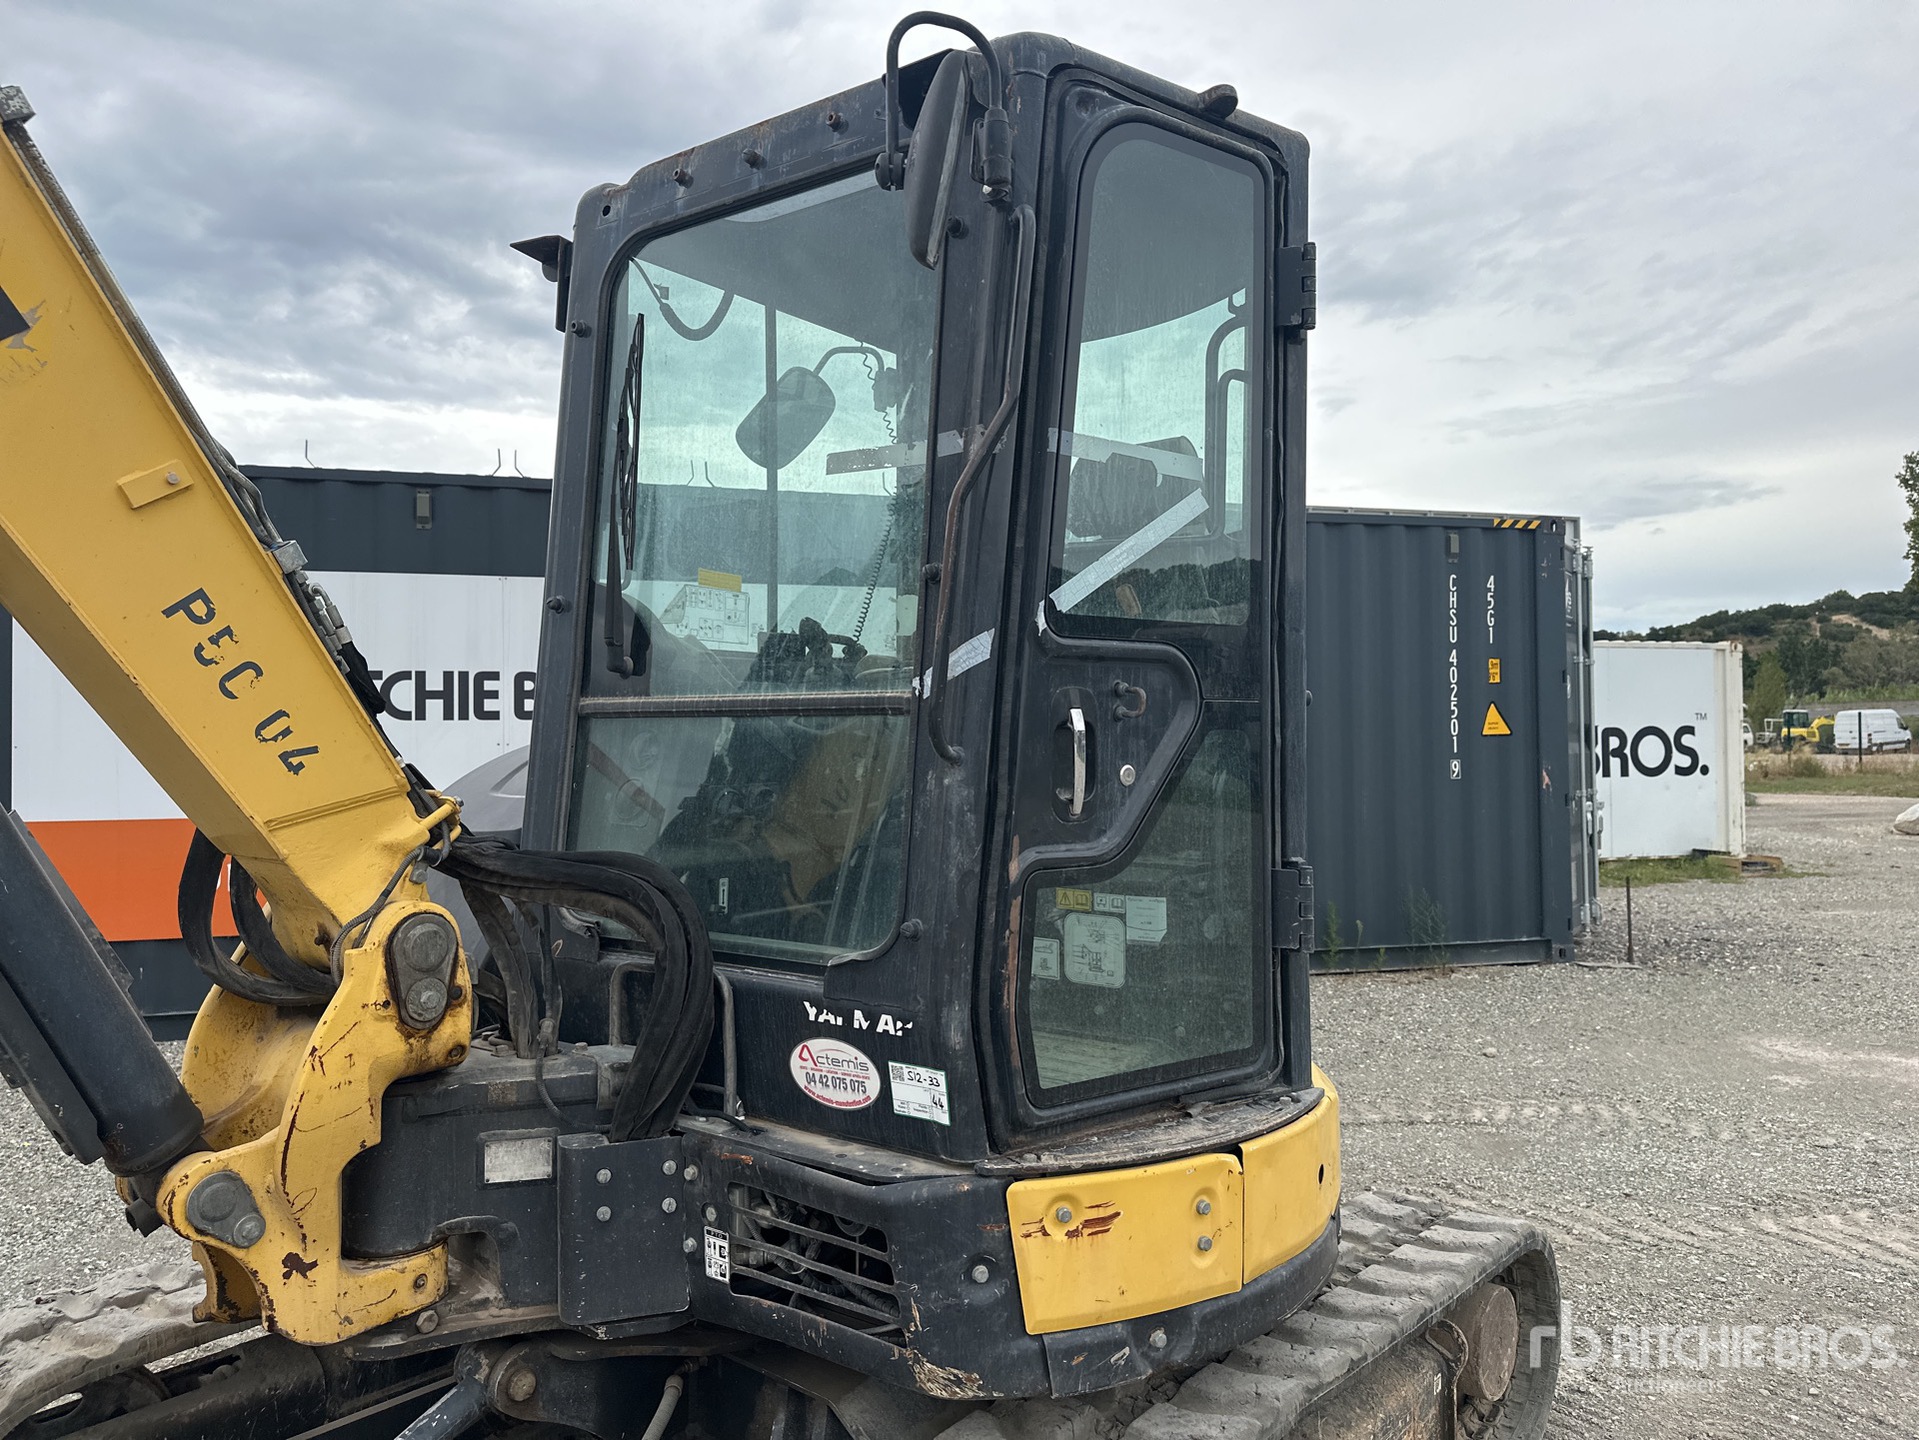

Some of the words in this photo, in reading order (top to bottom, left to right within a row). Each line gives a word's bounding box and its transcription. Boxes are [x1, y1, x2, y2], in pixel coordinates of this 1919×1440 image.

[1449, 574, 1458, 643] CHSU
[1486, 575, 1495, 644] 45G1
[1449, 648, 1459, 753] 402501
[1695, 713, 1708, 721] TM
[1452, 760, 1459, 777] 9
[798, 1044, 869, 1072] Actemis
[805, 1071, 817, 1086] 04
[818, 1074, 830, 1088] 42
[831, 1076, 848, 1091] 075
[850, 1078, 867, 1094] 075
[932, 1094, 944, 1110] 44
